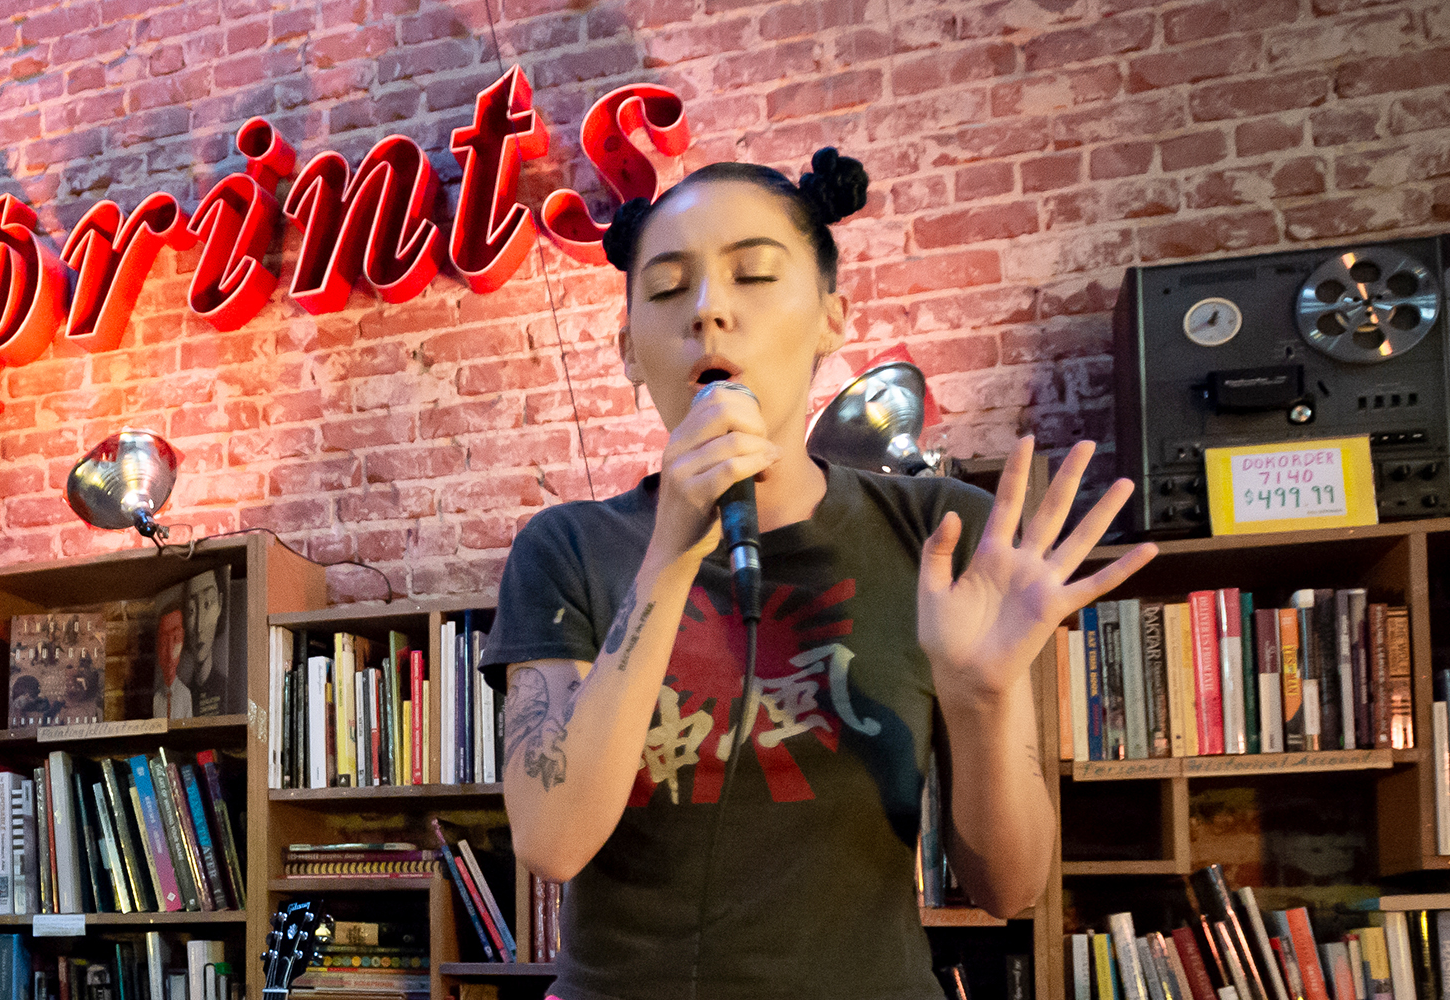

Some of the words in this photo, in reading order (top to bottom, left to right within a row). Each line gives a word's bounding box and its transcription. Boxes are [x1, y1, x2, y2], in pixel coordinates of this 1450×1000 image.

[1242, 451, 1335, 471] DOKORDER
[1258, 469, 1314, 485] 7140
[24, 620, 93, 634] INSIDE
